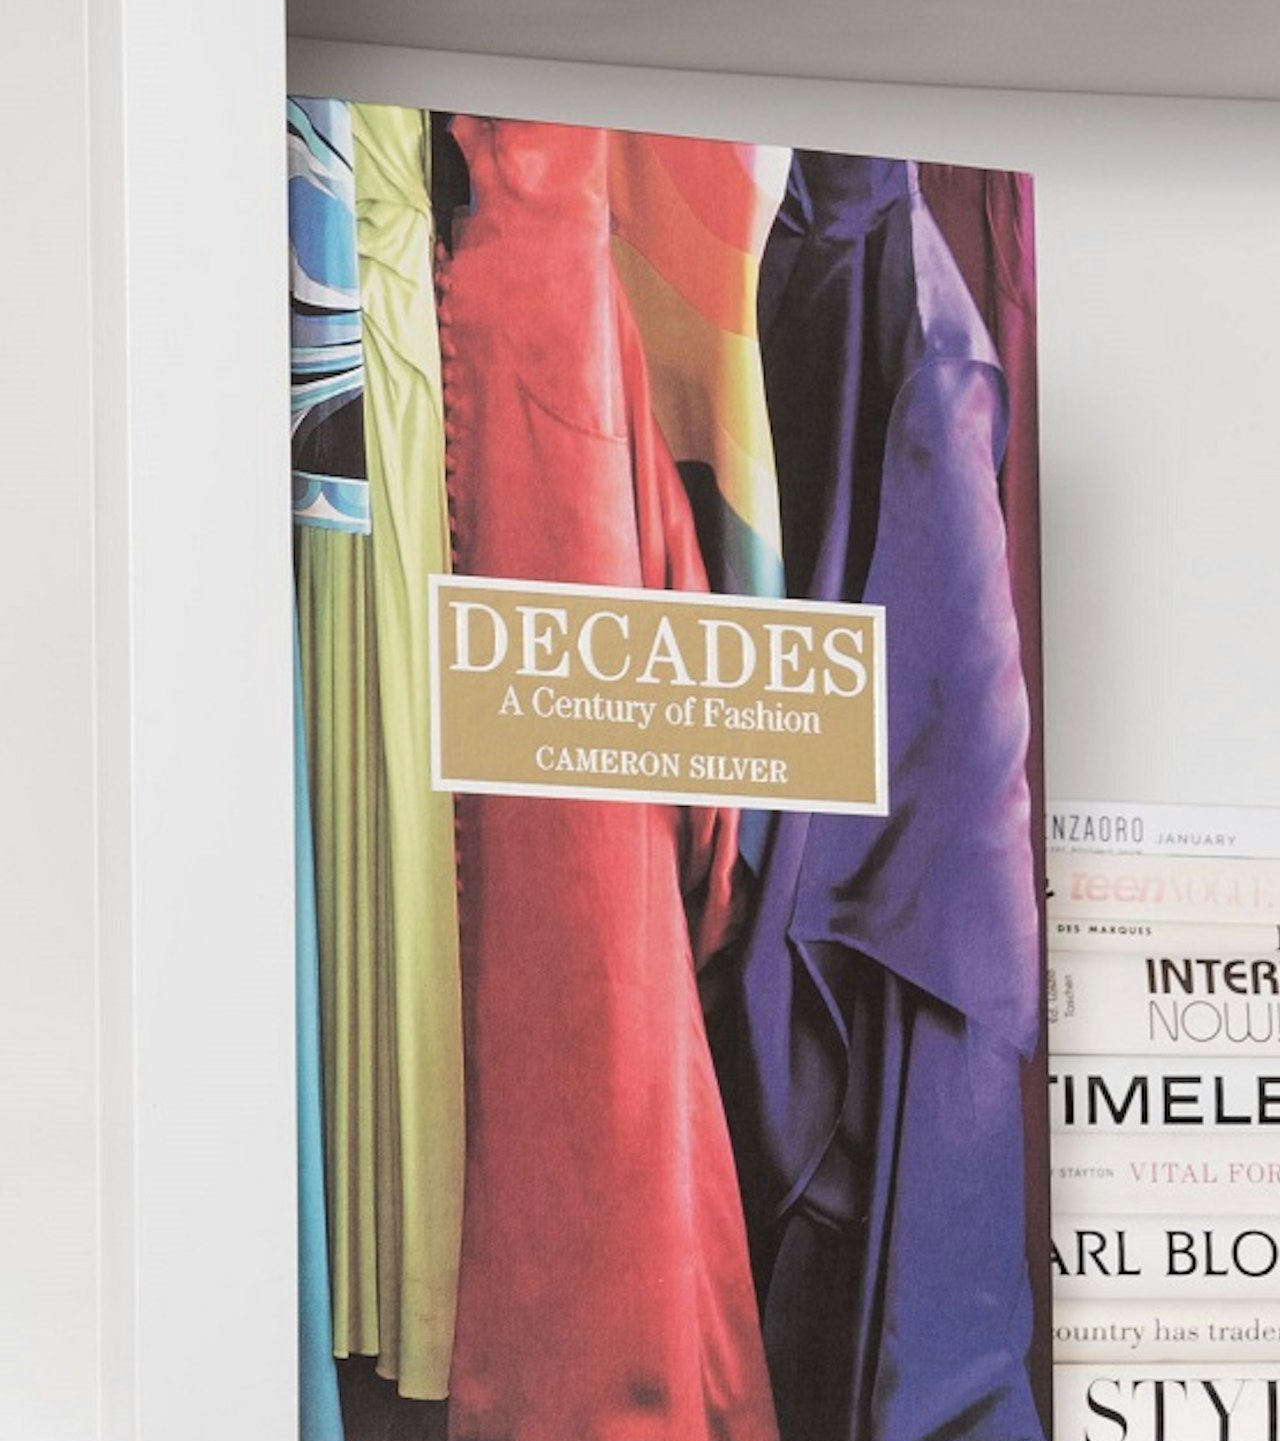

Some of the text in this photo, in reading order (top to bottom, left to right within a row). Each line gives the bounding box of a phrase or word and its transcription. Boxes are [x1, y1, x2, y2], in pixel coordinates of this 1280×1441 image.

[448, 601, 872, 701] DECADES
[498, 688, 822, 737] A Century of Fashion
[534, 744, 789, 784] CAMERON SILVER
[1129, 1162, 1218, 1184] VITAL
